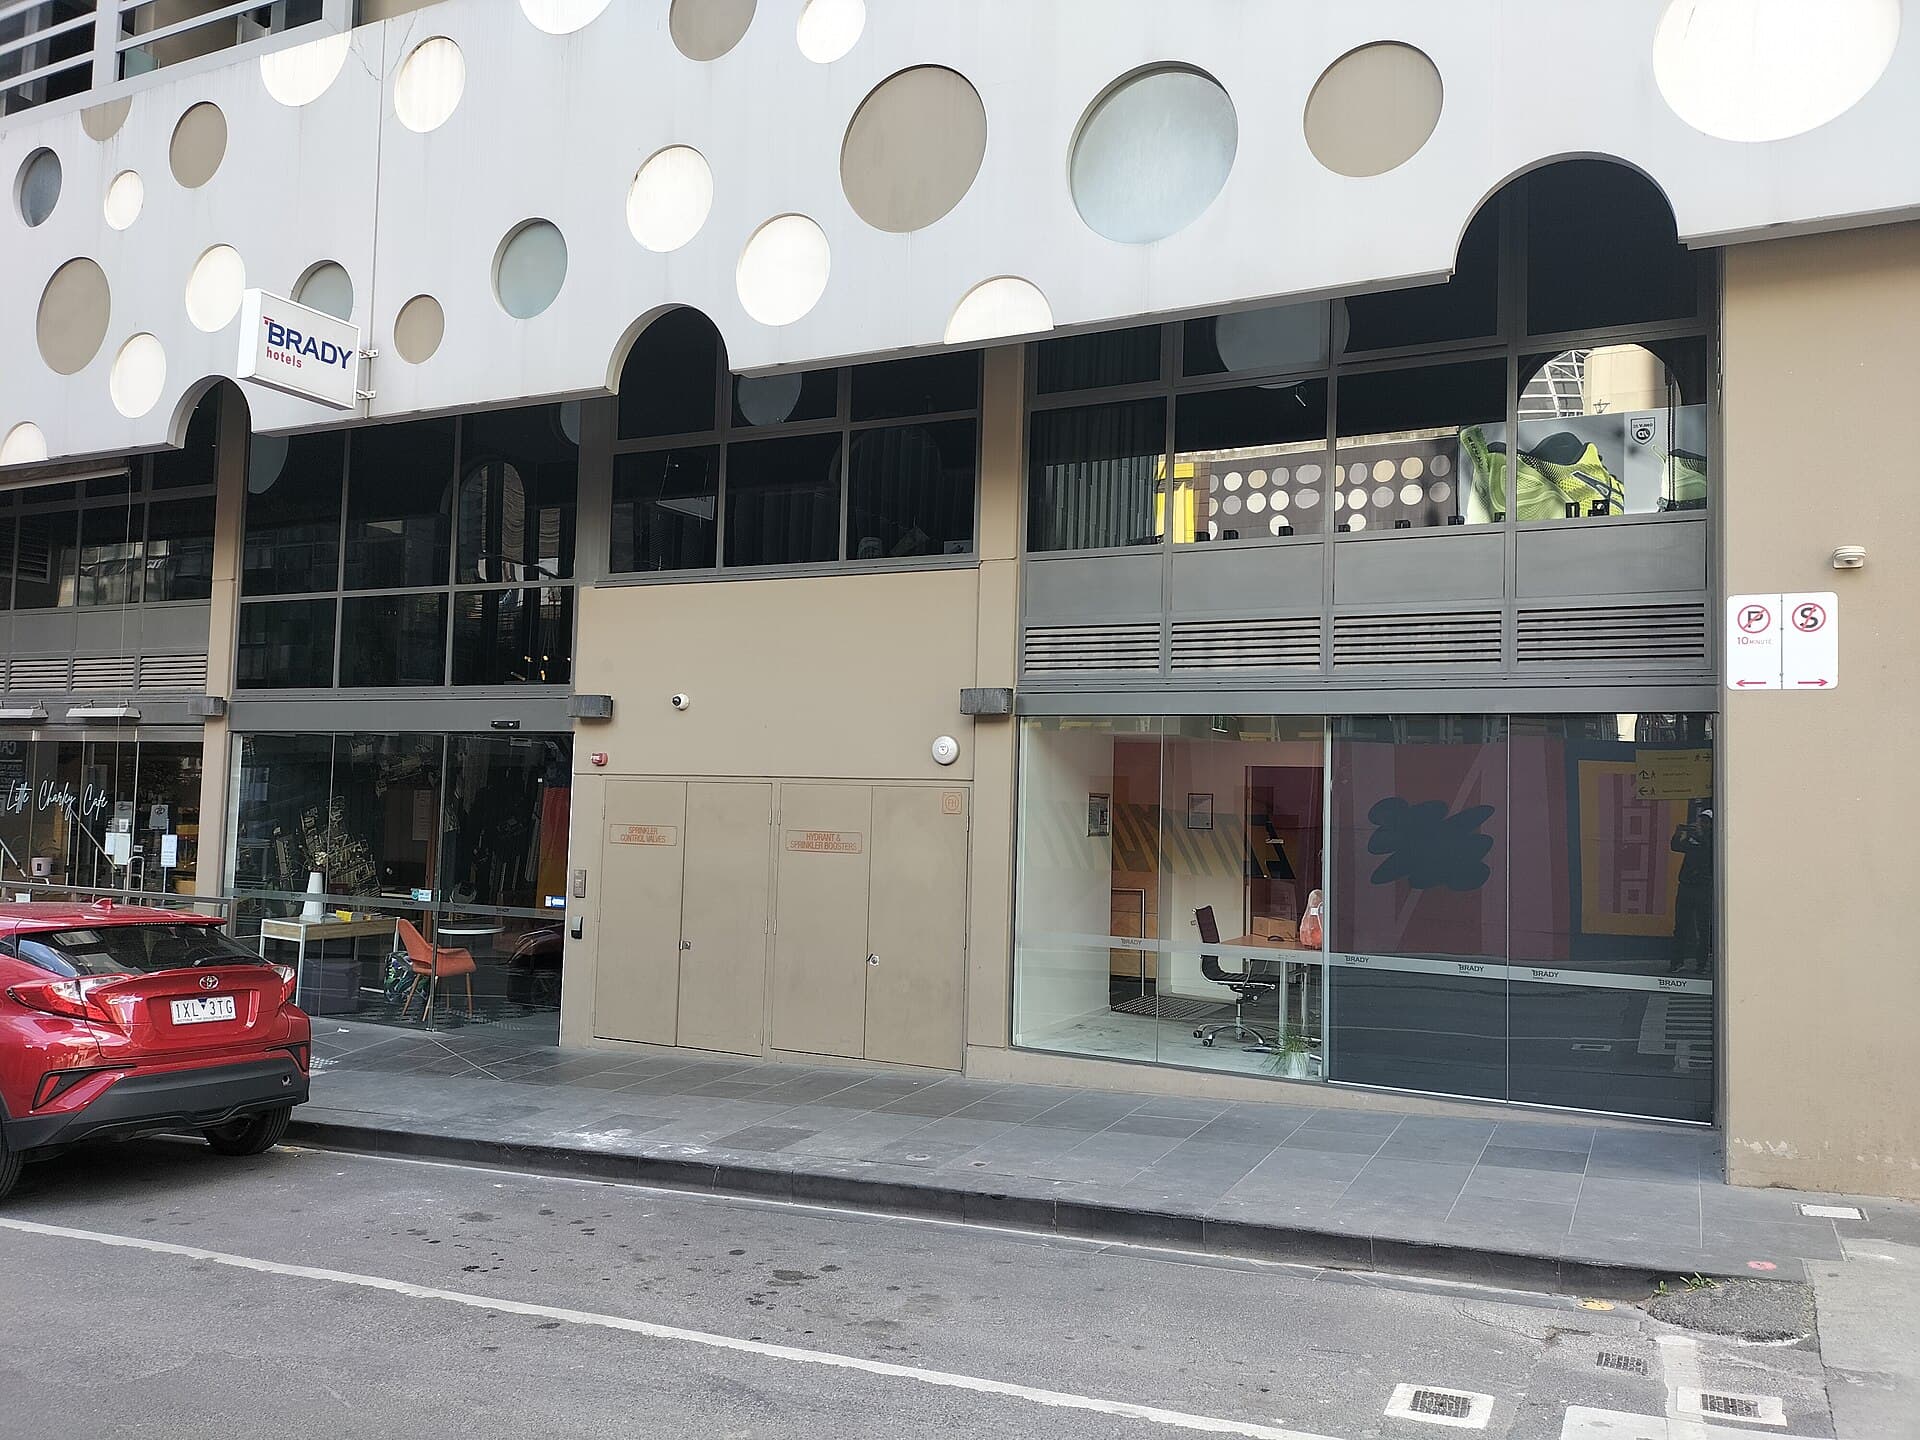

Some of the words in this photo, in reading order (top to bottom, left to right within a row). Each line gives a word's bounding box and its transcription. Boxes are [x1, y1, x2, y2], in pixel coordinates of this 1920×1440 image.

[263, 317, 353, 369] BRADY
[266, 346, 302, 368] hotels
[1737, 636, 1749, 645] 10
[83, 783, 108, 821] Cafe
[629, 826, 658, 834] SPRINKLER
[620, 834, 645, 842] CONTROL
[646, 835, 666, 843] VALVES
[806, 833, 835, 841] HYDRANT
[790, 840, 824, 849] SPRINKLER
[824, 842, 858, 850] BOOSTERS
[1345, 955, 1370, 963] BRADY
[1458, 964, 1484, 972] BRADY
[1532, 970, 1560, 978] BRADY
[1659, 979, 1687, 987] BRADY
[176, 1003, 199, 1018] 1XL
[209, 1000, 233, 1015] 3TG
